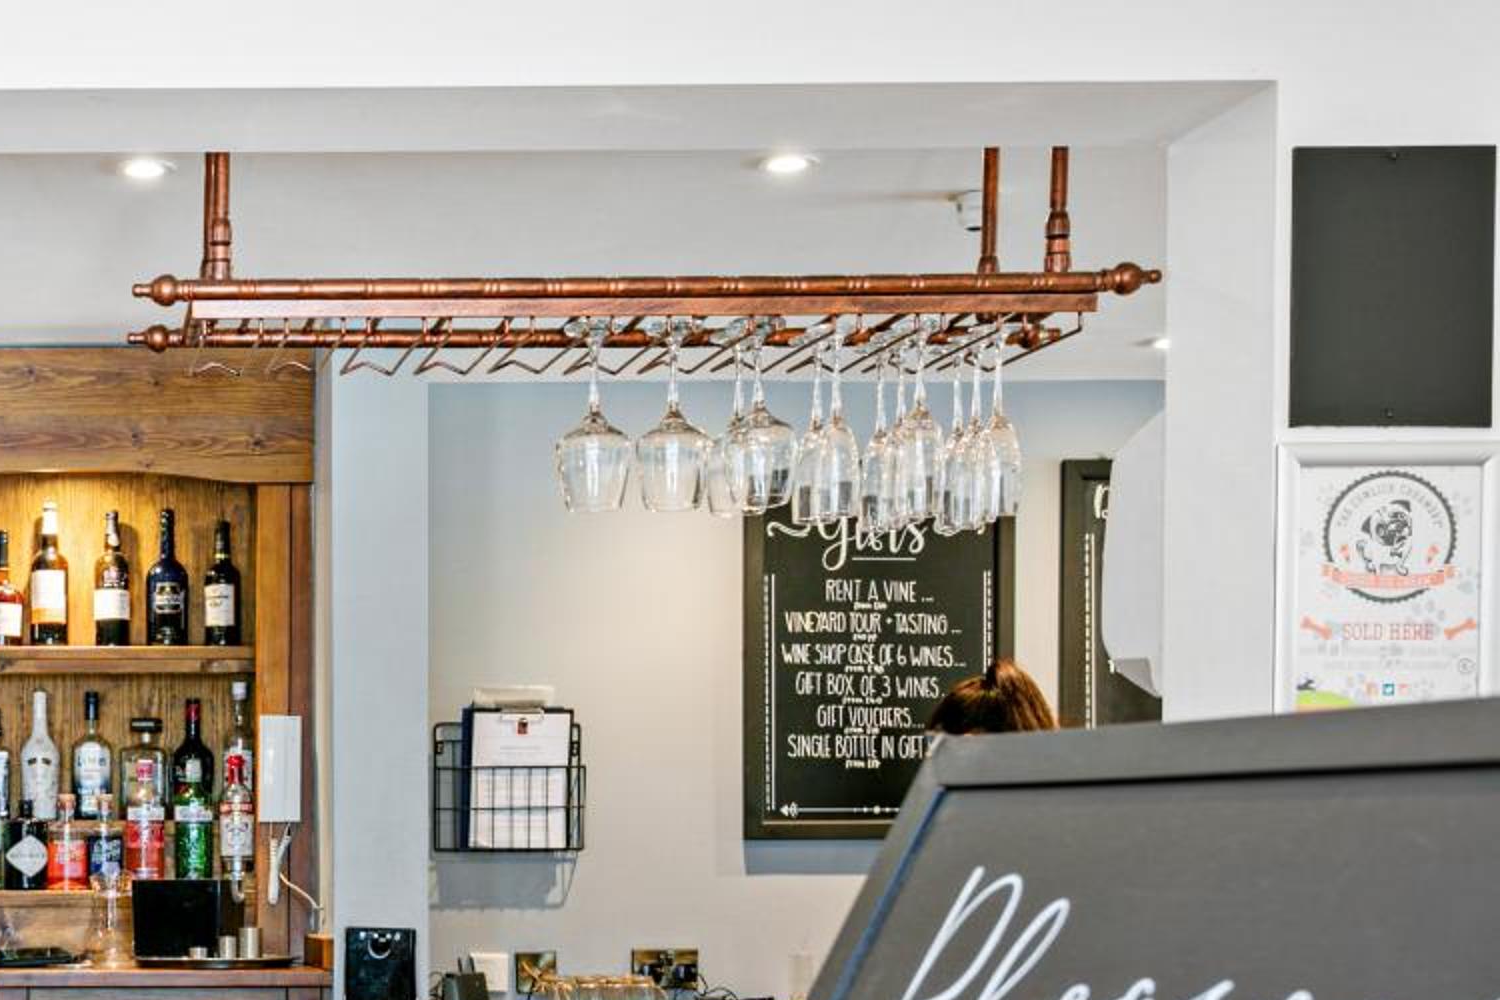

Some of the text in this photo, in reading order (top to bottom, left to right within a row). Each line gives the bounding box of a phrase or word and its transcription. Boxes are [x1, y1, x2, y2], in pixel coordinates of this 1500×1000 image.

[825, 579, 861, 601] RENT
[868, 580, 878, 601] A
[883, 580, 916, 602] VINE
[785, 611, 847, 633] VINEYARD
[849, 612, 882, 633] TOUR
[894, 613, 948, 634] TASTING
[1343, 623, 1434, 640] SOLD HERE
[781, 643, 811, 665] WINE
[815, 643, 846, 665] SHOP
[847, 643, 875, 665] CASE
[879, 644, 894, 666] OF
[897, 645, 907, 665] 6
[795, 671, 822, 695] GIFT
[827, 672, 855, 696] BOX
[861, 674, 876, 697] OF
[881, 675, 891, 697] 3
[816, 704, 843, 728] GIFT
[787, 734, 831, 758] SINGLE
[835, 734, 877, 759] BOTTLE
[881, 735, 895, 759] IN
[899, 735, 924, 760] GIFT
